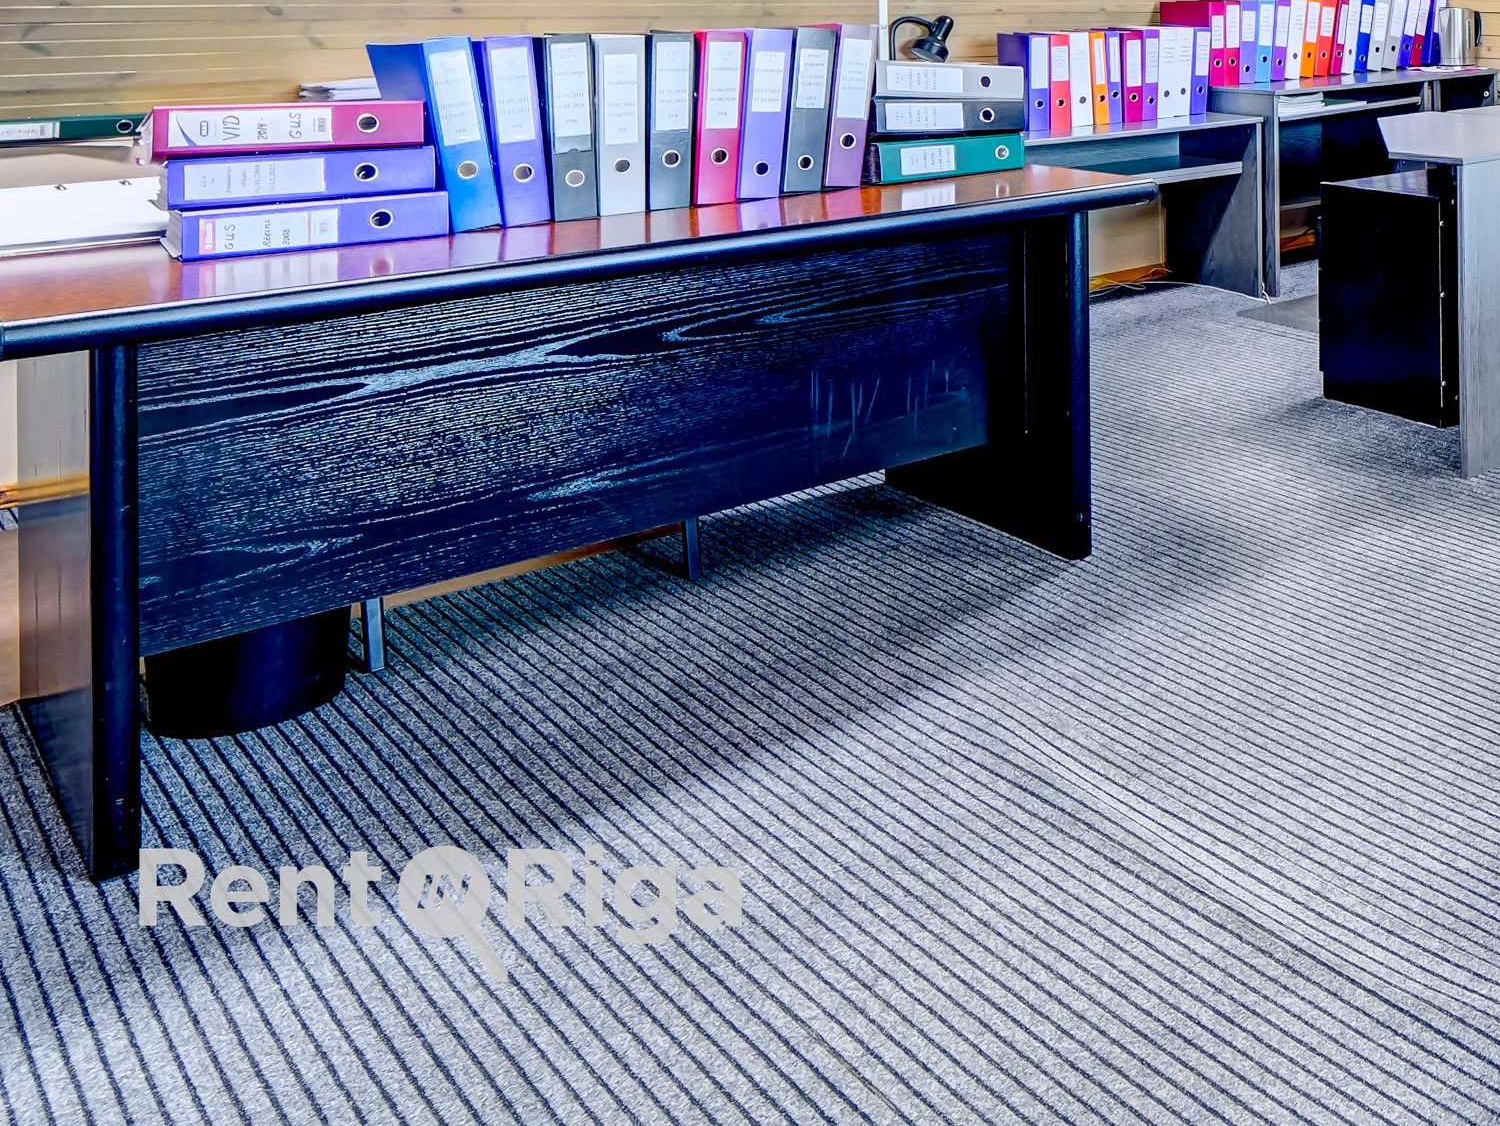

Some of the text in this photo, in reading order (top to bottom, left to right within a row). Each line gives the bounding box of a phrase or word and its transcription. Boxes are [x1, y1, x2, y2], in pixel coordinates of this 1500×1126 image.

[222, 114, 241, 141] VID
[288, 112, 302, 139] GUS
[224, 224, 236, 250] GUS
